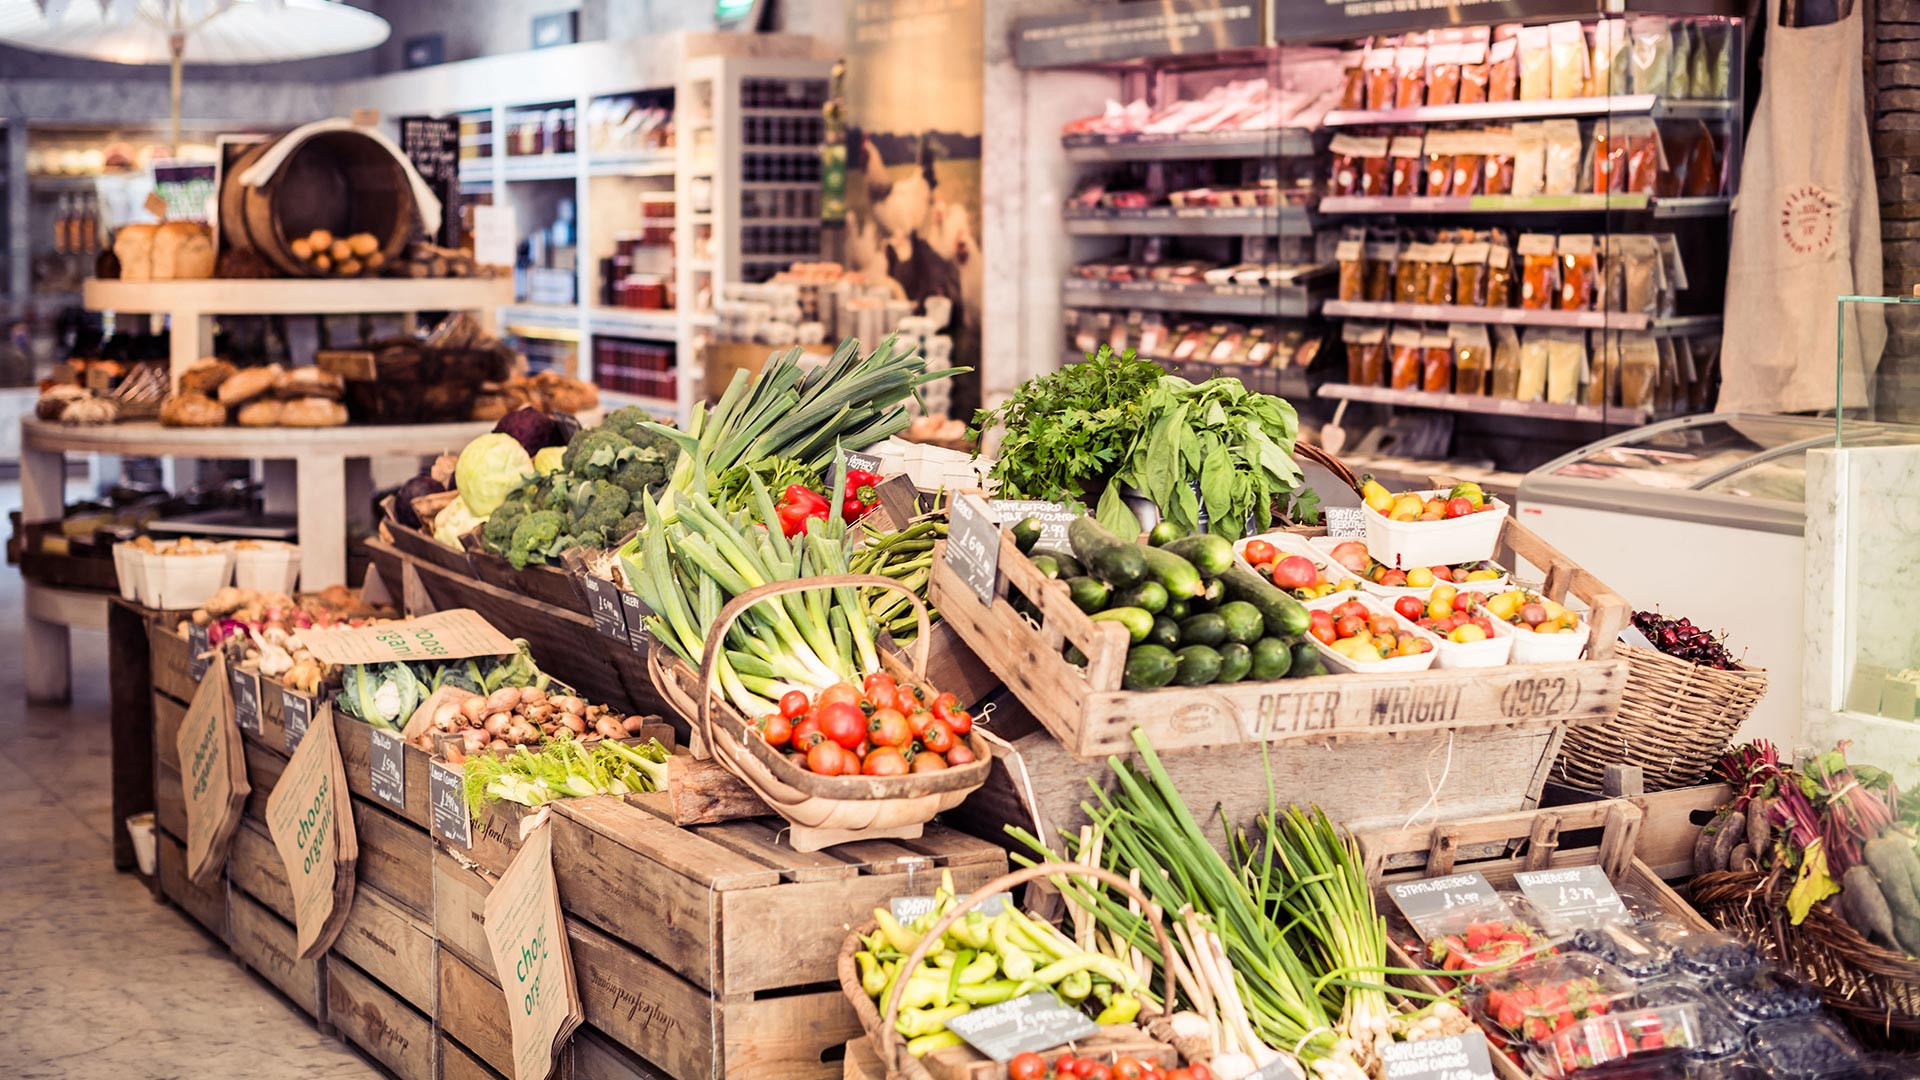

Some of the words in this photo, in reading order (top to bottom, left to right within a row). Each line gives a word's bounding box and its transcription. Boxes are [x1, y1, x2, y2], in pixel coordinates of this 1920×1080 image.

[993, 501, 1062, 512] DAYLESFORD
[1254, 691, 1341, 734] PETER
[1369, 684, 1468, 726] WRIGHT
[1500, 678, 1582, 718] (1962)
[297, 775, 329, 849] choose
[304, 801, 333, 875] organic
